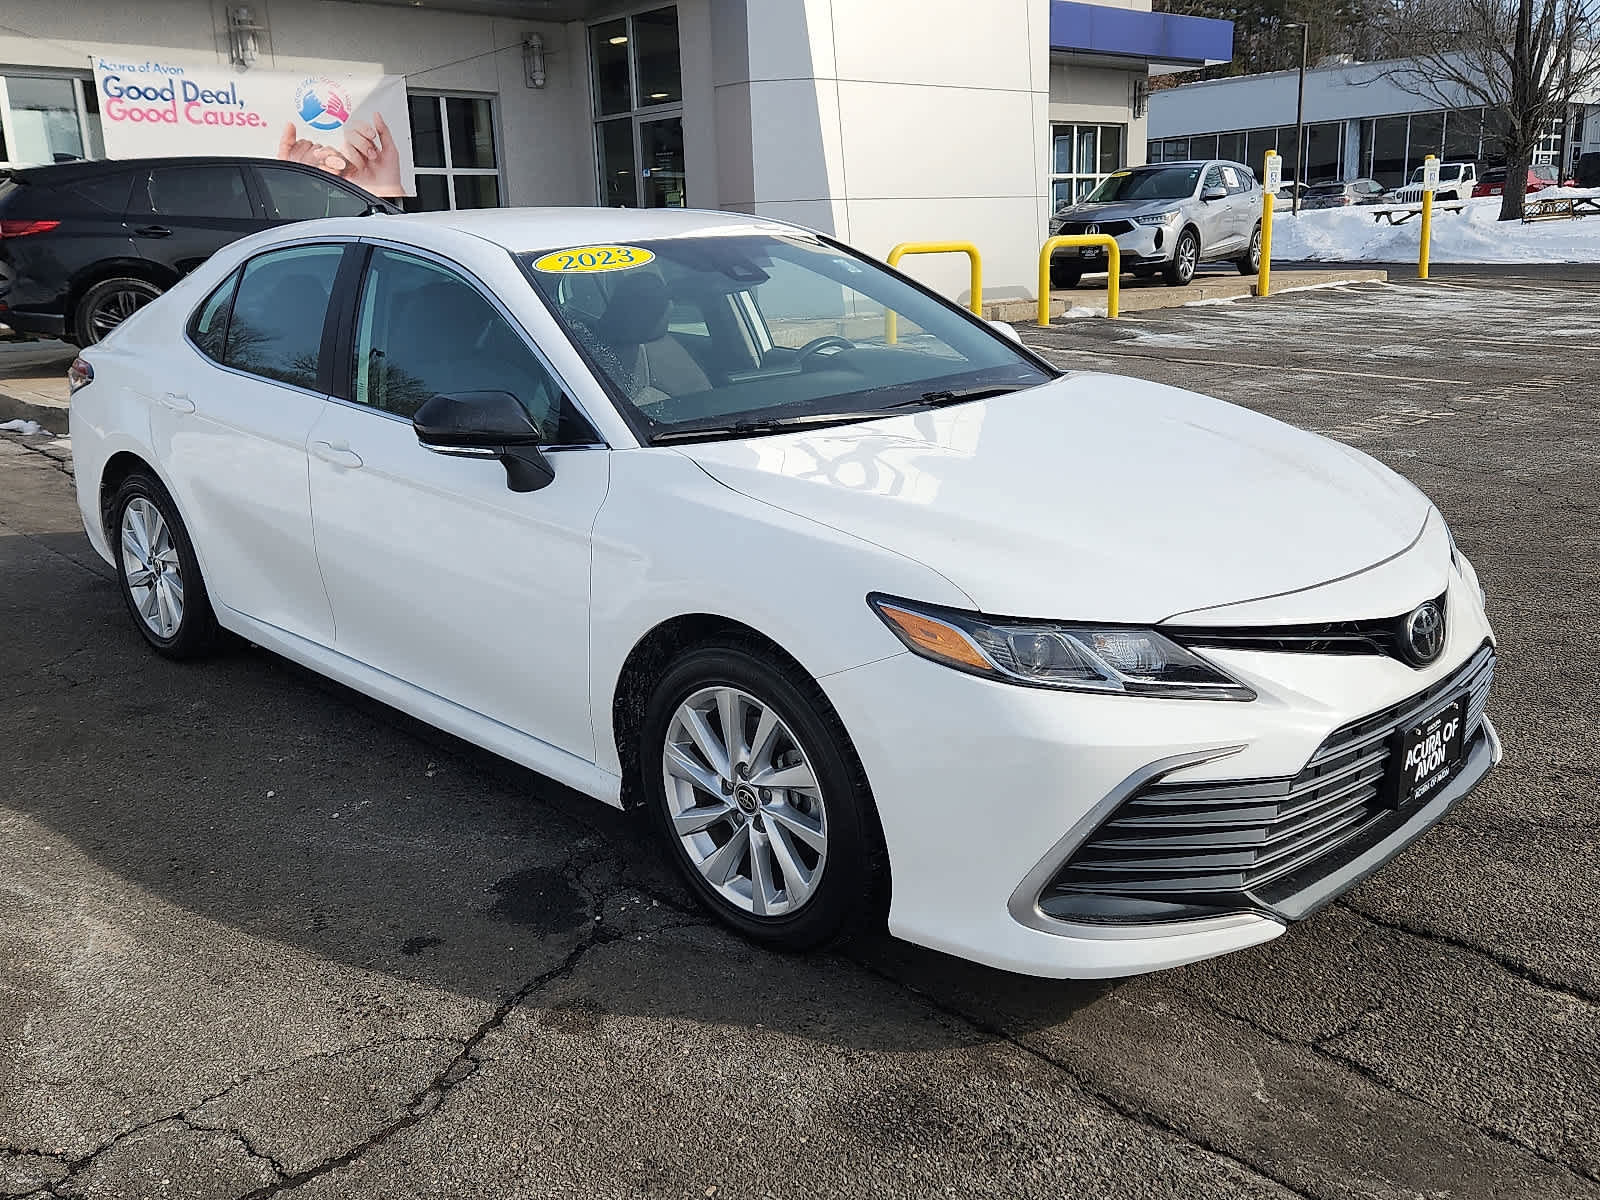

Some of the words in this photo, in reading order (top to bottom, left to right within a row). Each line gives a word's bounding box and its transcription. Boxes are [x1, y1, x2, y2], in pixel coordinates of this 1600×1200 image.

[99, 60, 136, 73] Acura
[138, 62, 150, 73] of
[153, 63, 184, 75] Avon
[102, 75, 175, 102] Good
[181, 79, 245, 110] Deal,
[105, 97, 178, 124] Good
[184, 101, 267, 128] Cause.
[558, 248, 635, 270] 2023
[1405, 730, 1442, 771] ACURA
[1443, 718, 1459, 742] OF
[1415, 744, 1446, 783] AVON
